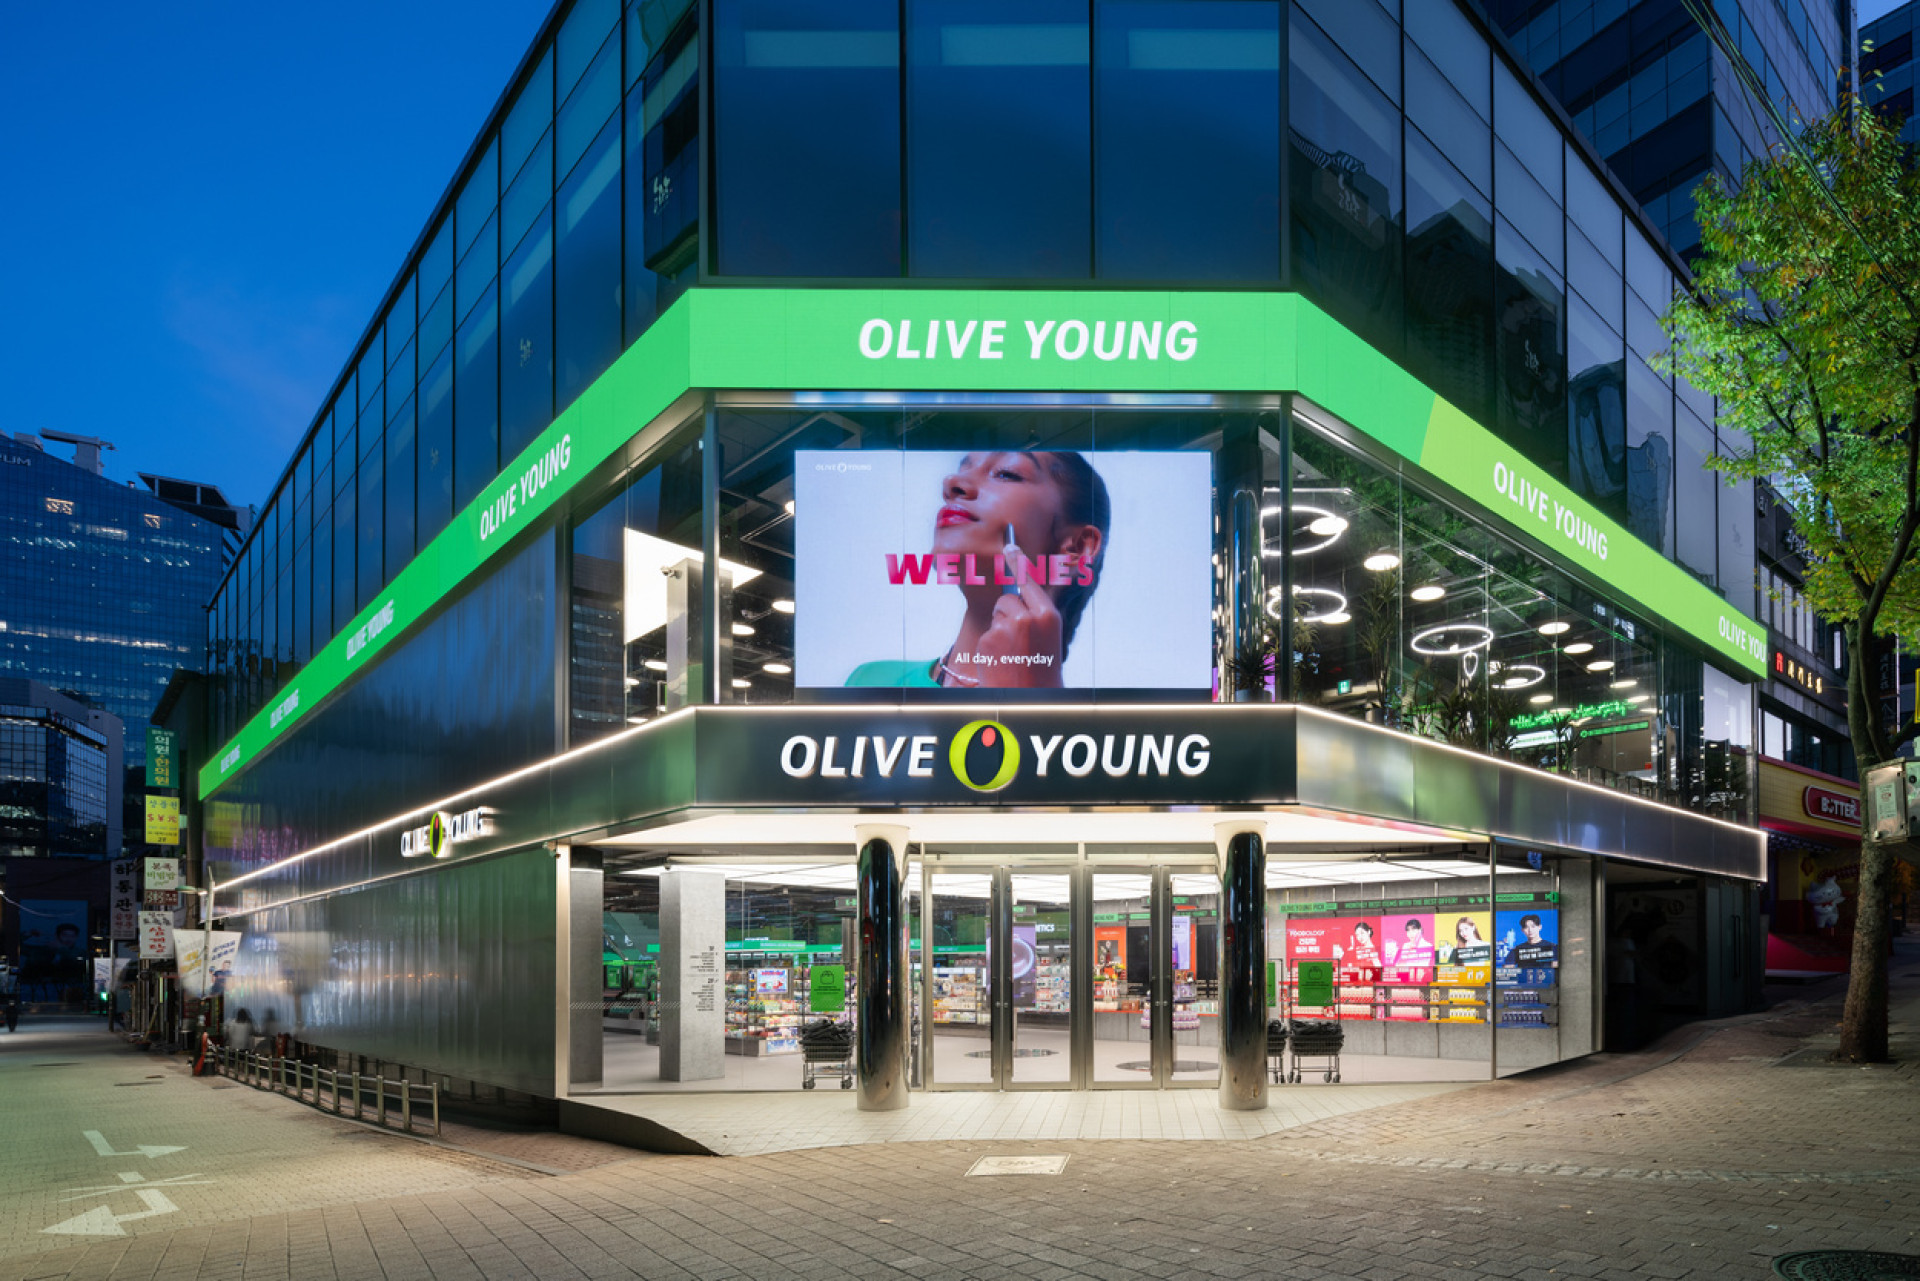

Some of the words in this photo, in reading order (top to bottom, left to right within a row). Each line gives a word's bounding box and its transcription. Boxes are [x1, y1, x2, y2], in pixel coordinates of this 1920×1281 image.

[858, 318, 1007, 359] OLIVE
[1024, 319, 1199, 362] YOUNG
[0, 453, 32, 467] UM
[480, 483, 517, 541] OLIVE
[520, 433, 571, 506] YOUNG
[1493, 462, 1548, 522] OLIVE
[1553, 500, 1608, 560] YOUNG
[347, 625, 367, 661] OLIVE
[368, 599, 394, 642] YOUNG
[1718, 615, 1746, 651] OLIVE
[955, 652, 970, 664] All
[972, 652, 998, 667] day,
[1000, 652, 1054, 667] everyday
[780, 735, 937, 778] OLIVE
[1030, 734, 1211, 778] YOUNG
